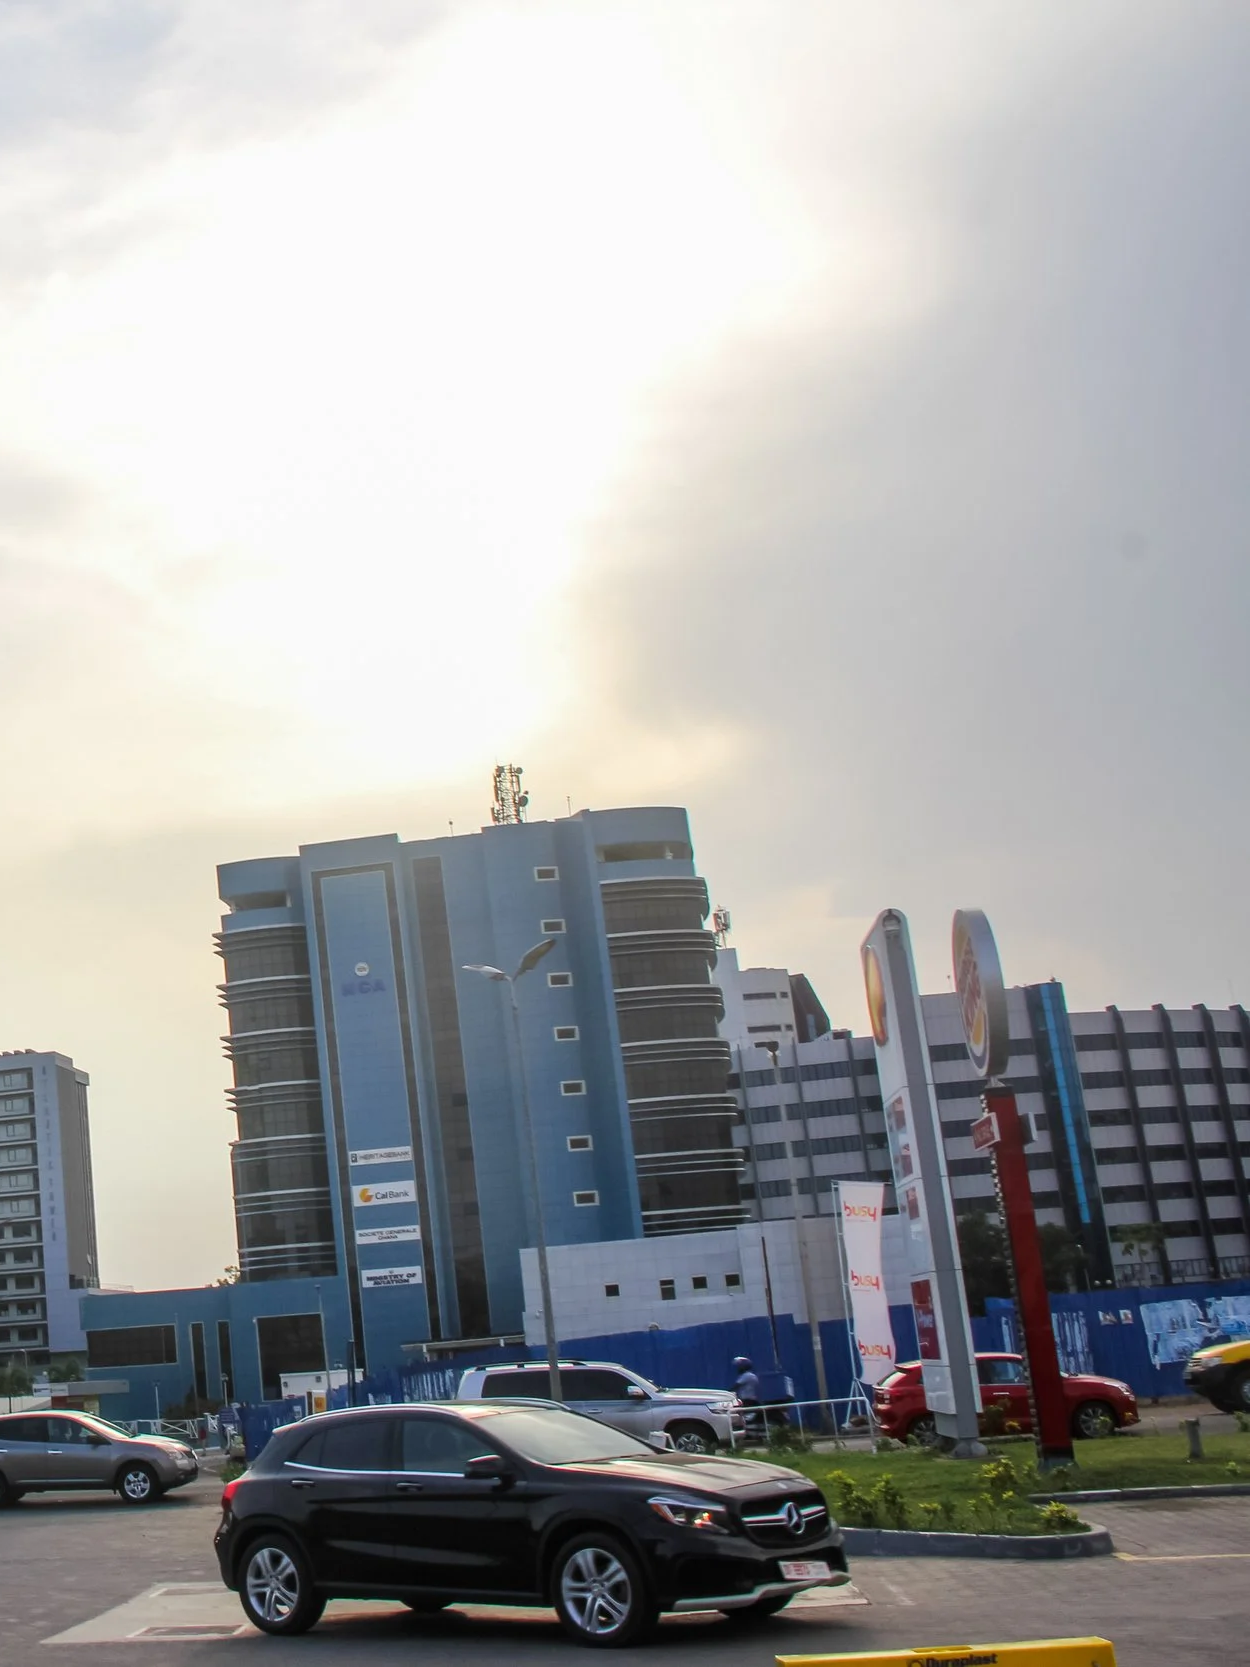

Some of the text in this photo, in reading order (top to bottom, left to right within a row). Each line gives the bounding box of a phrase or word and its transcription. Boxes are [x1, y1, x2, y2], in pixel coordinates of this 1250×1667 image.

[843, 1201, 877, 1222] busy
[851, 1270, 880, 1291] busy
[858, 1339, 892, 1360] busy
